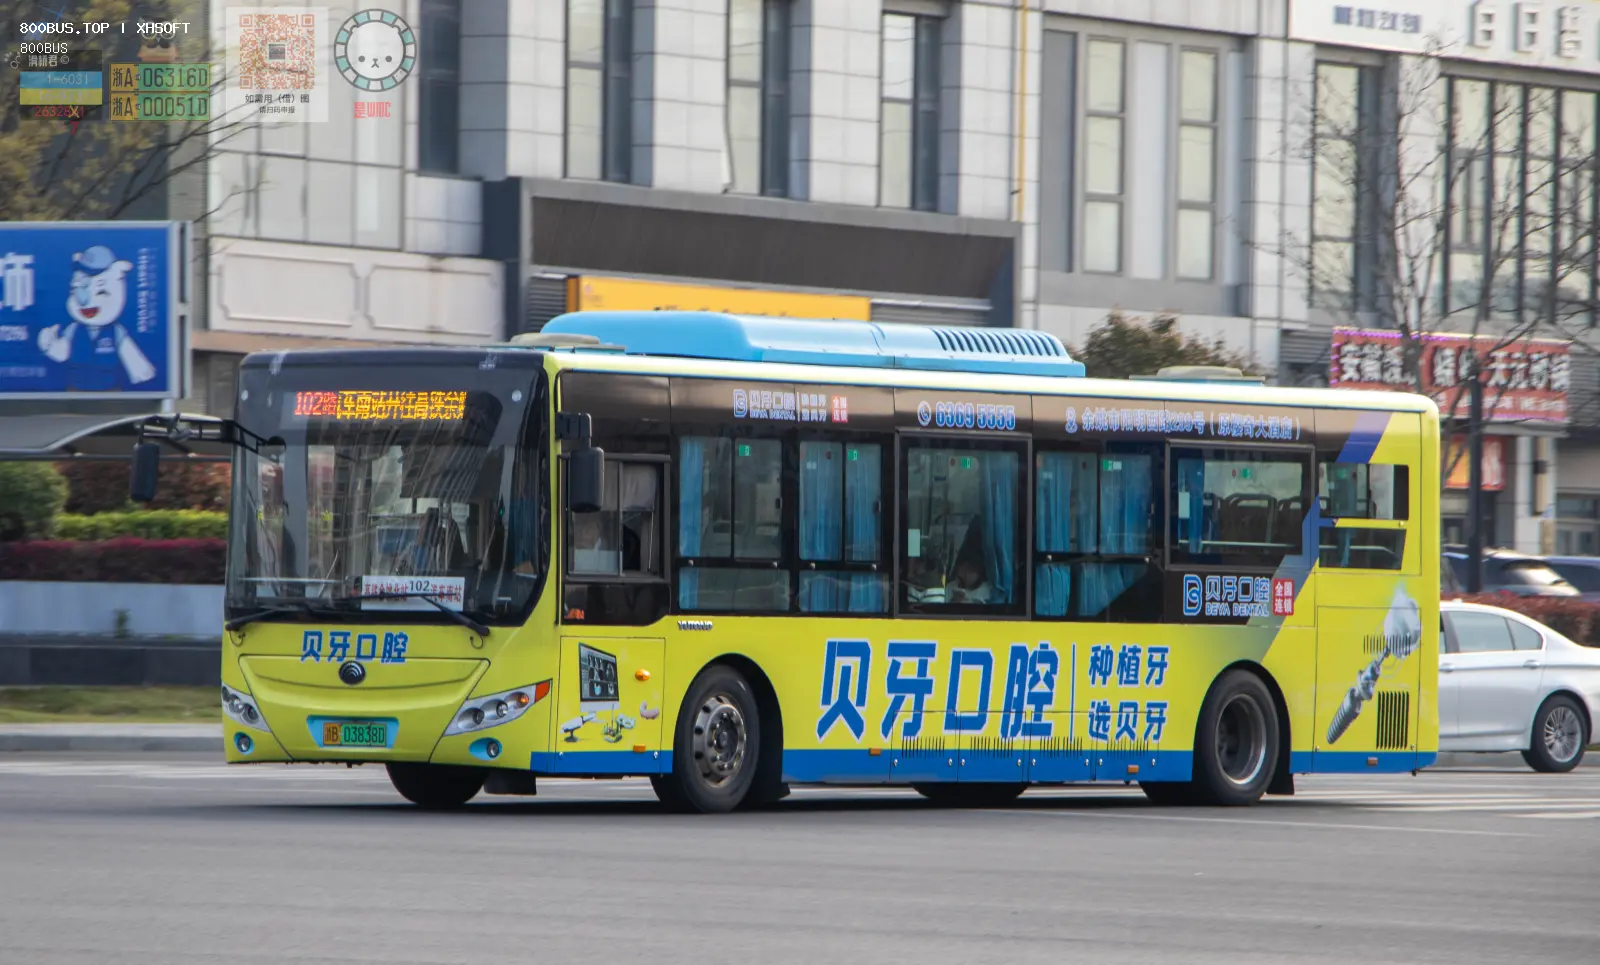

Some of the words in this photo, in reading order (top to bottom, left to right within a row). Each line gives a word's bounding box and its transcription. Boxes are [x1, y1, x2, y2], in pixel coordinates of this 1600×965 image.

[936, 401, 974, 428] 6369
[977, 403, 1016, 430] 5555
[410, 581, 430, 592] 102
[1205, 575, 1270, 602] 贝牙口腔
[1205, 602, 1230, 616] BEYA
[1233, 603, 1269, 617] DENTAL
[300, 630, 409, 664] 贝牙口腔
[1088, 644, 1170, 687] 种植牙
[816, 639, 1060, 742] 贝牙口腔
[1088, 699, 1169, 744] 选贝牙
